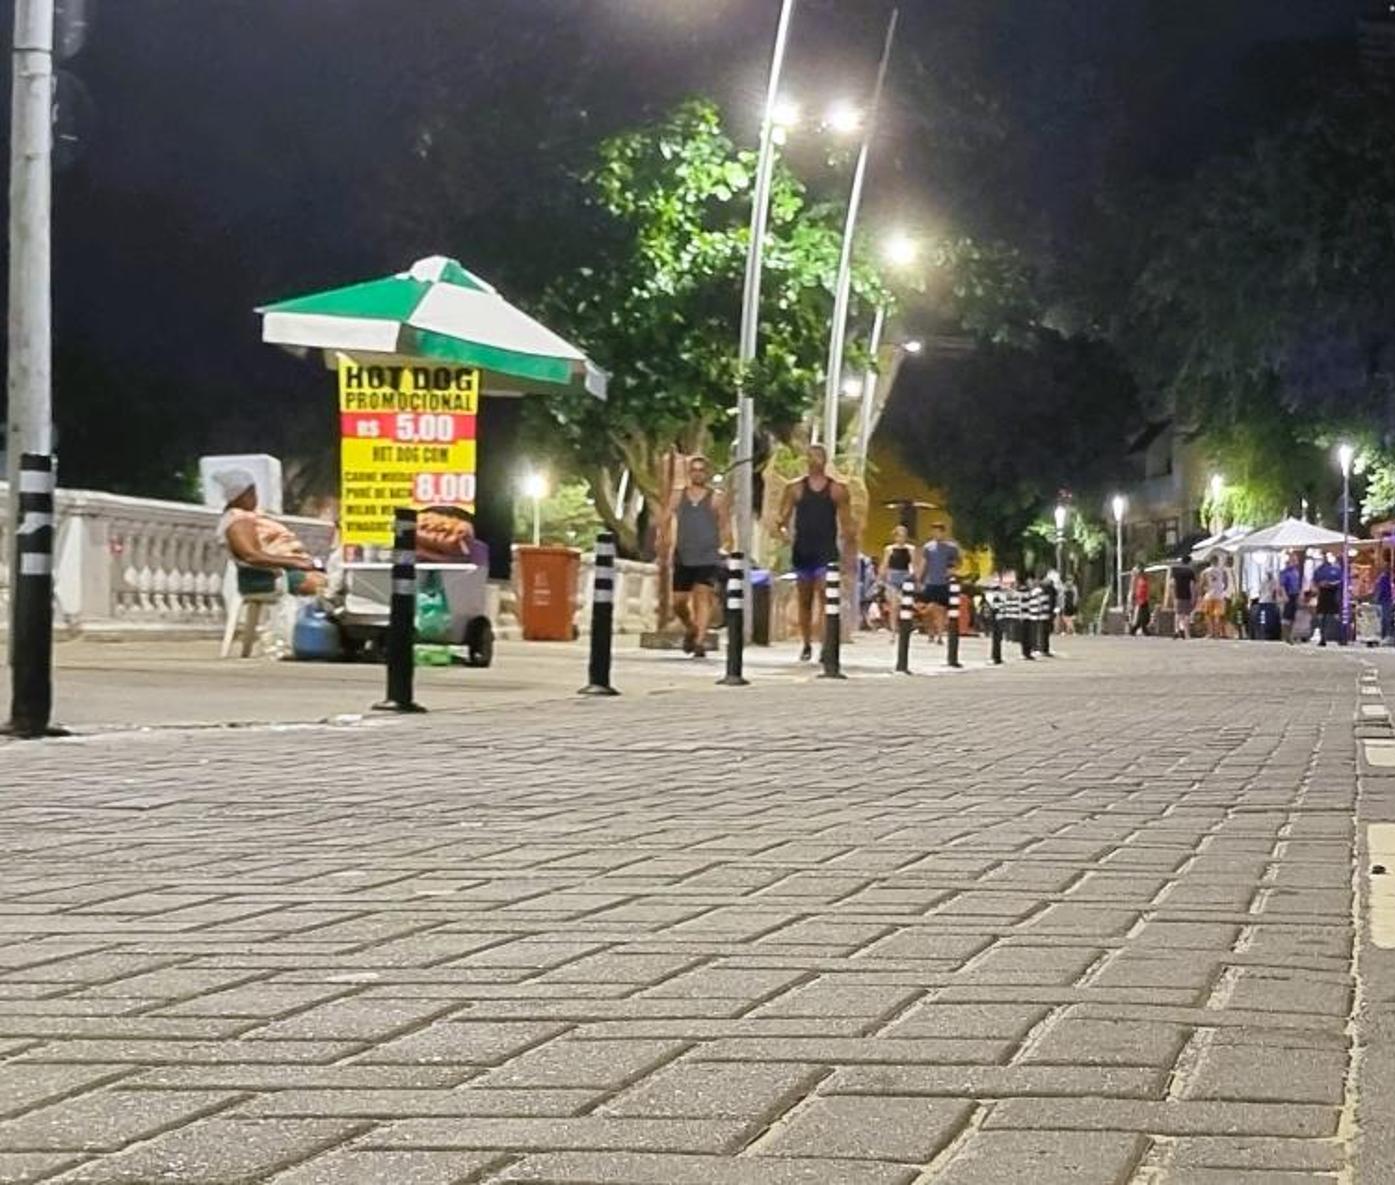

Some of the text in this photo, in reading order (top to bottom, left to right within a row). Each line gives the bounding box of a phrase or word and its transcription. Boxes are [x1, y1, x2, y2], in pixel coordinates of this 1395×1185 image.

[345, 366, 473, 391] HOT DOG
[345, 392, 473, 412] PROMOCIONAL
[396, 413, 455, 443] 5,00
[372, 446, 449, 463] HOT DOG COM
[416, 472, 477, 502] 8,00
